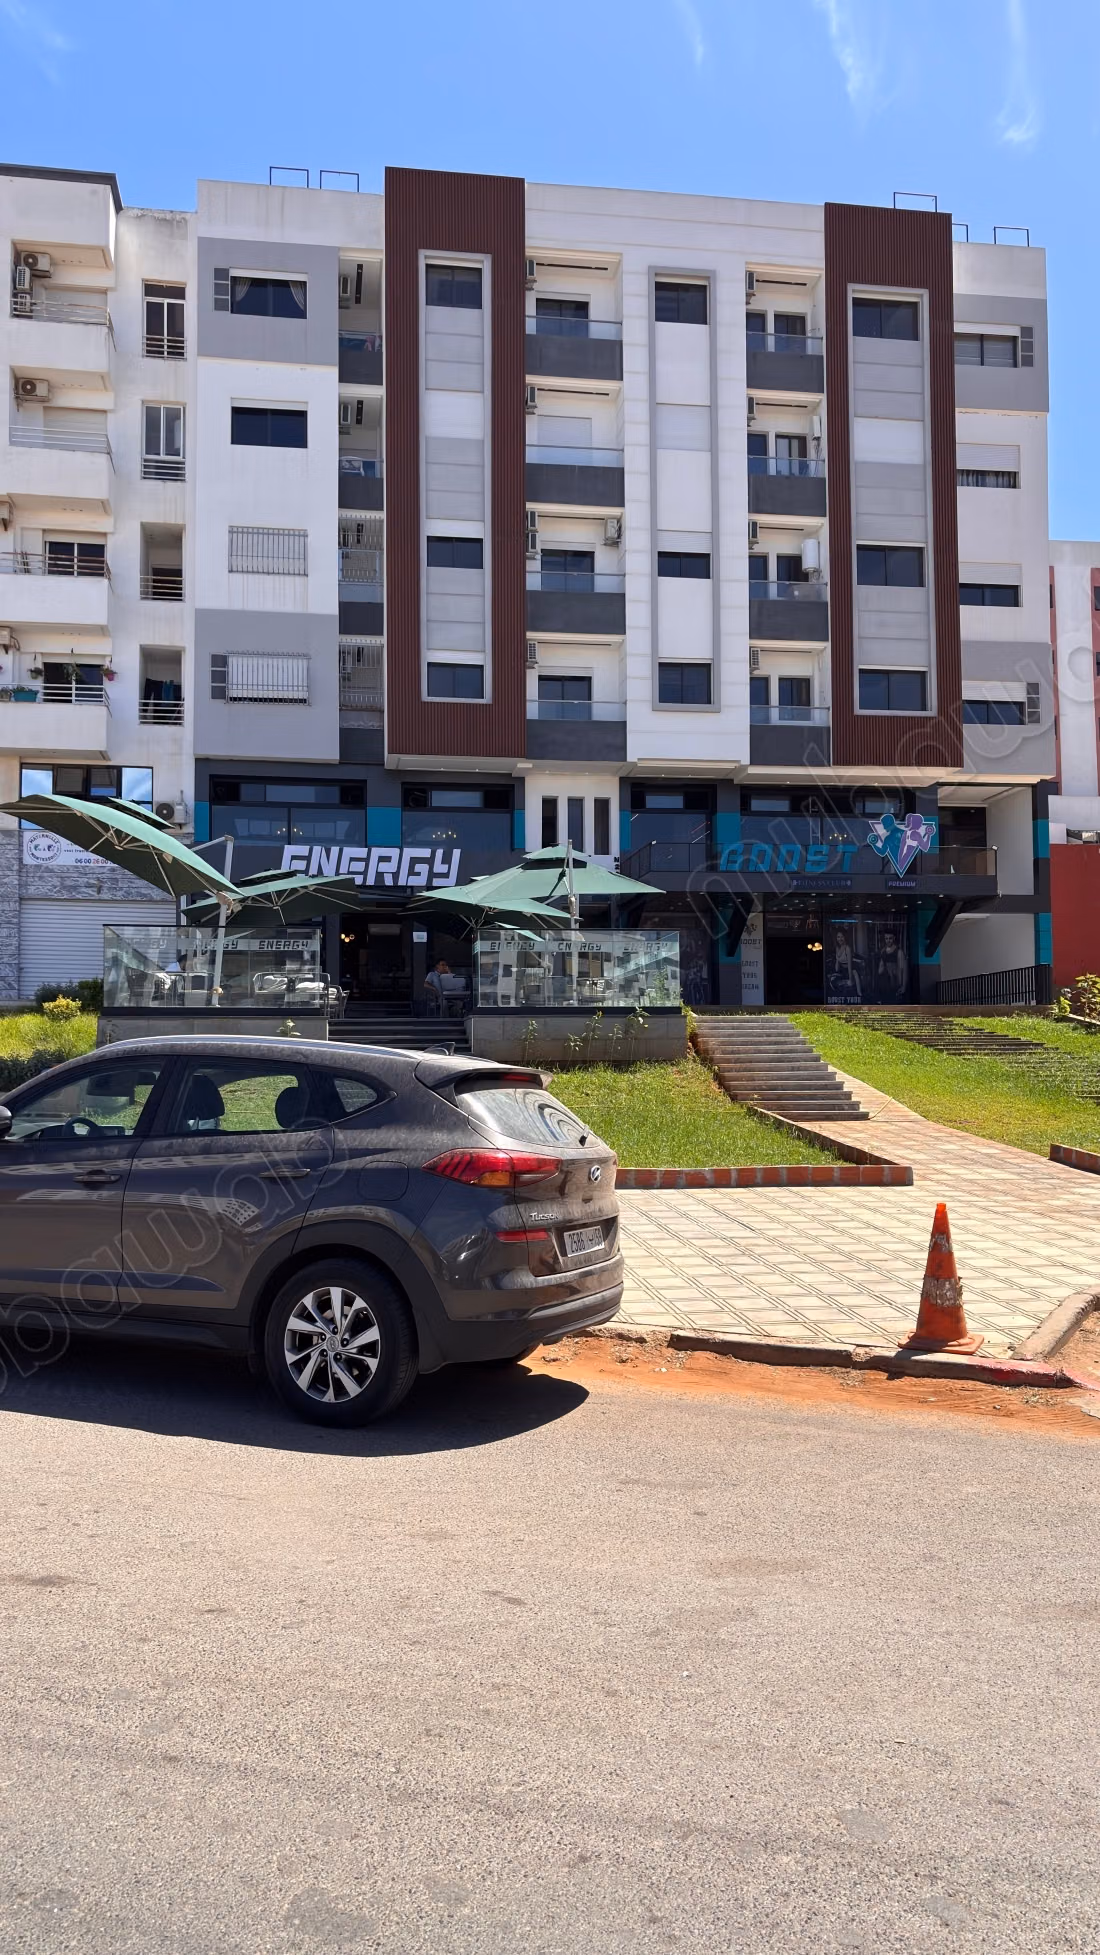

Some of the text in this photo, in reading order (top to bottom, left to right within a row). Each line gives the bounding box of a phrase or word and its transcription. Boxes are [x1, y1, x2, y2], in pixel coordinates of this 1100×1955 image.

[281, 845, 461, 886] ENERGY
[719, 842, 858, 873] BOOST
[258, 940, 309, 950] ENERGY
